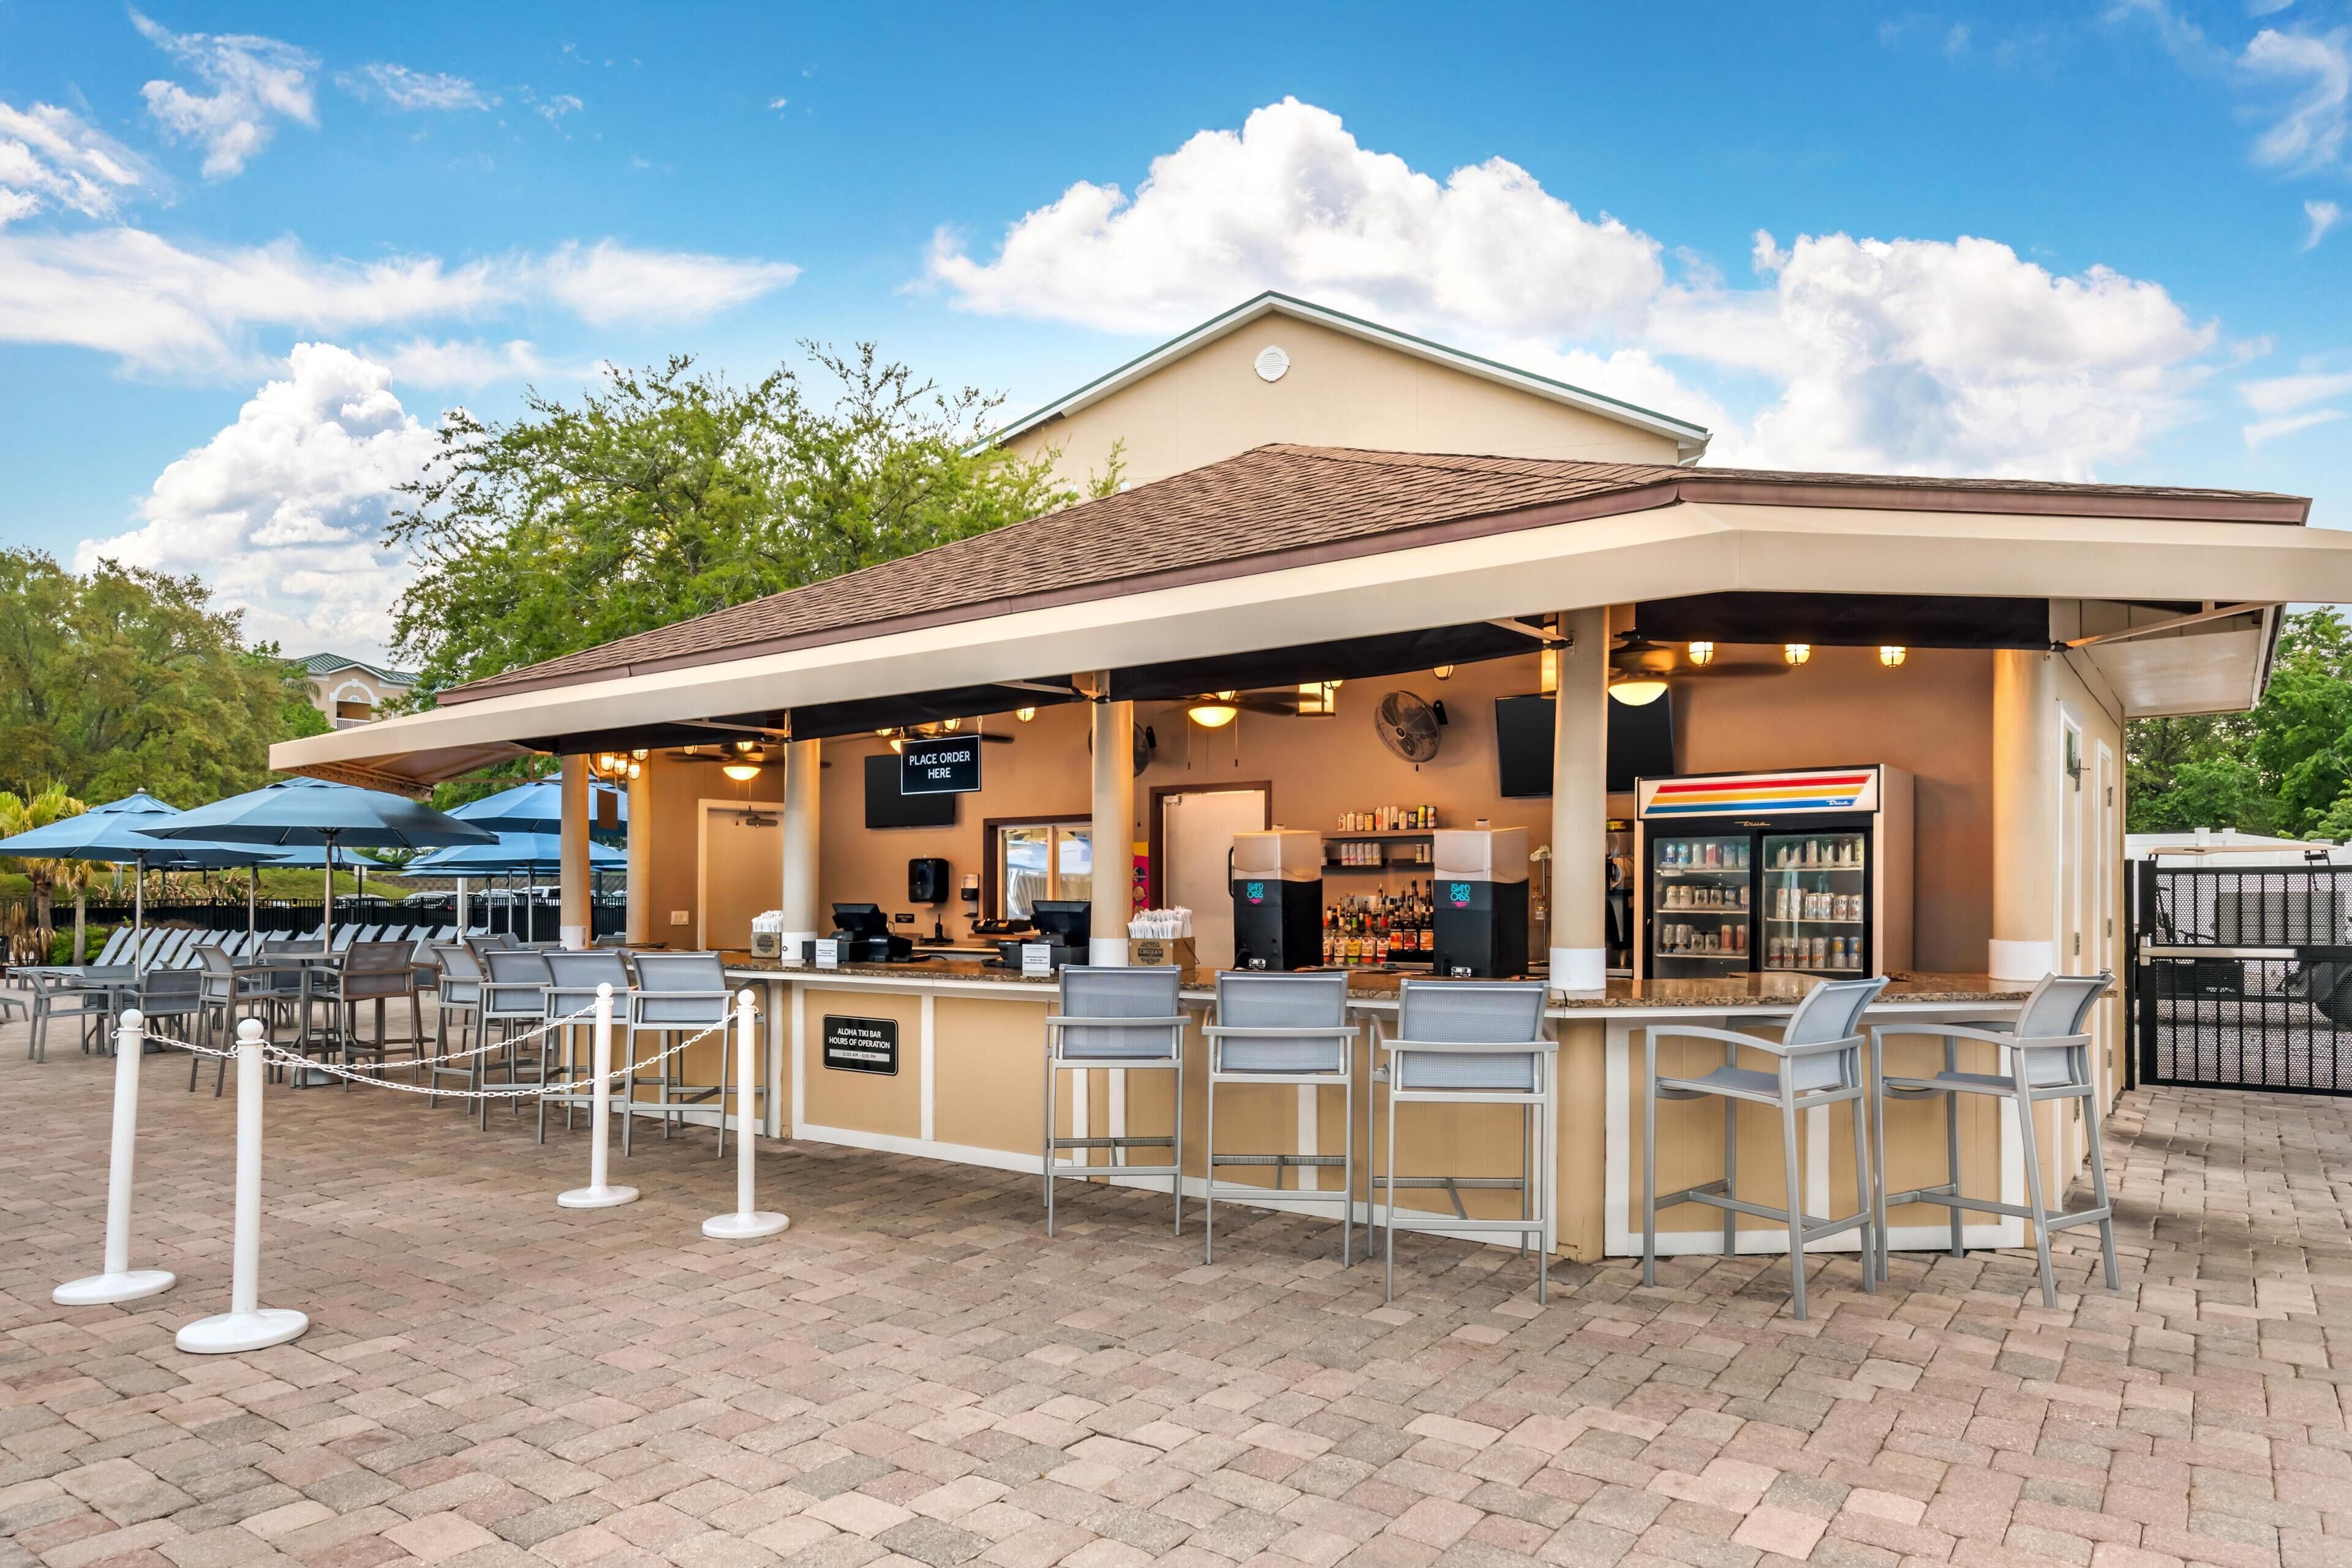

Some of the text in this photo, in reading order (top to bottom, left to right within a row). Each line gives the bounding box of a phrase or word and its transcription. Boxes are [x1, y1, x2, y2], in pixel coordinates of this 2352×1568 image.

[909, 751, 970, 766] PLACE ORDER
[928, 767, 951, 779] HERE
[837, 1028, 858, 1036] ALOHA
[829, 1036, 848, 1045] HOURS
[858, 1039, 891, 1049] OPERATION
